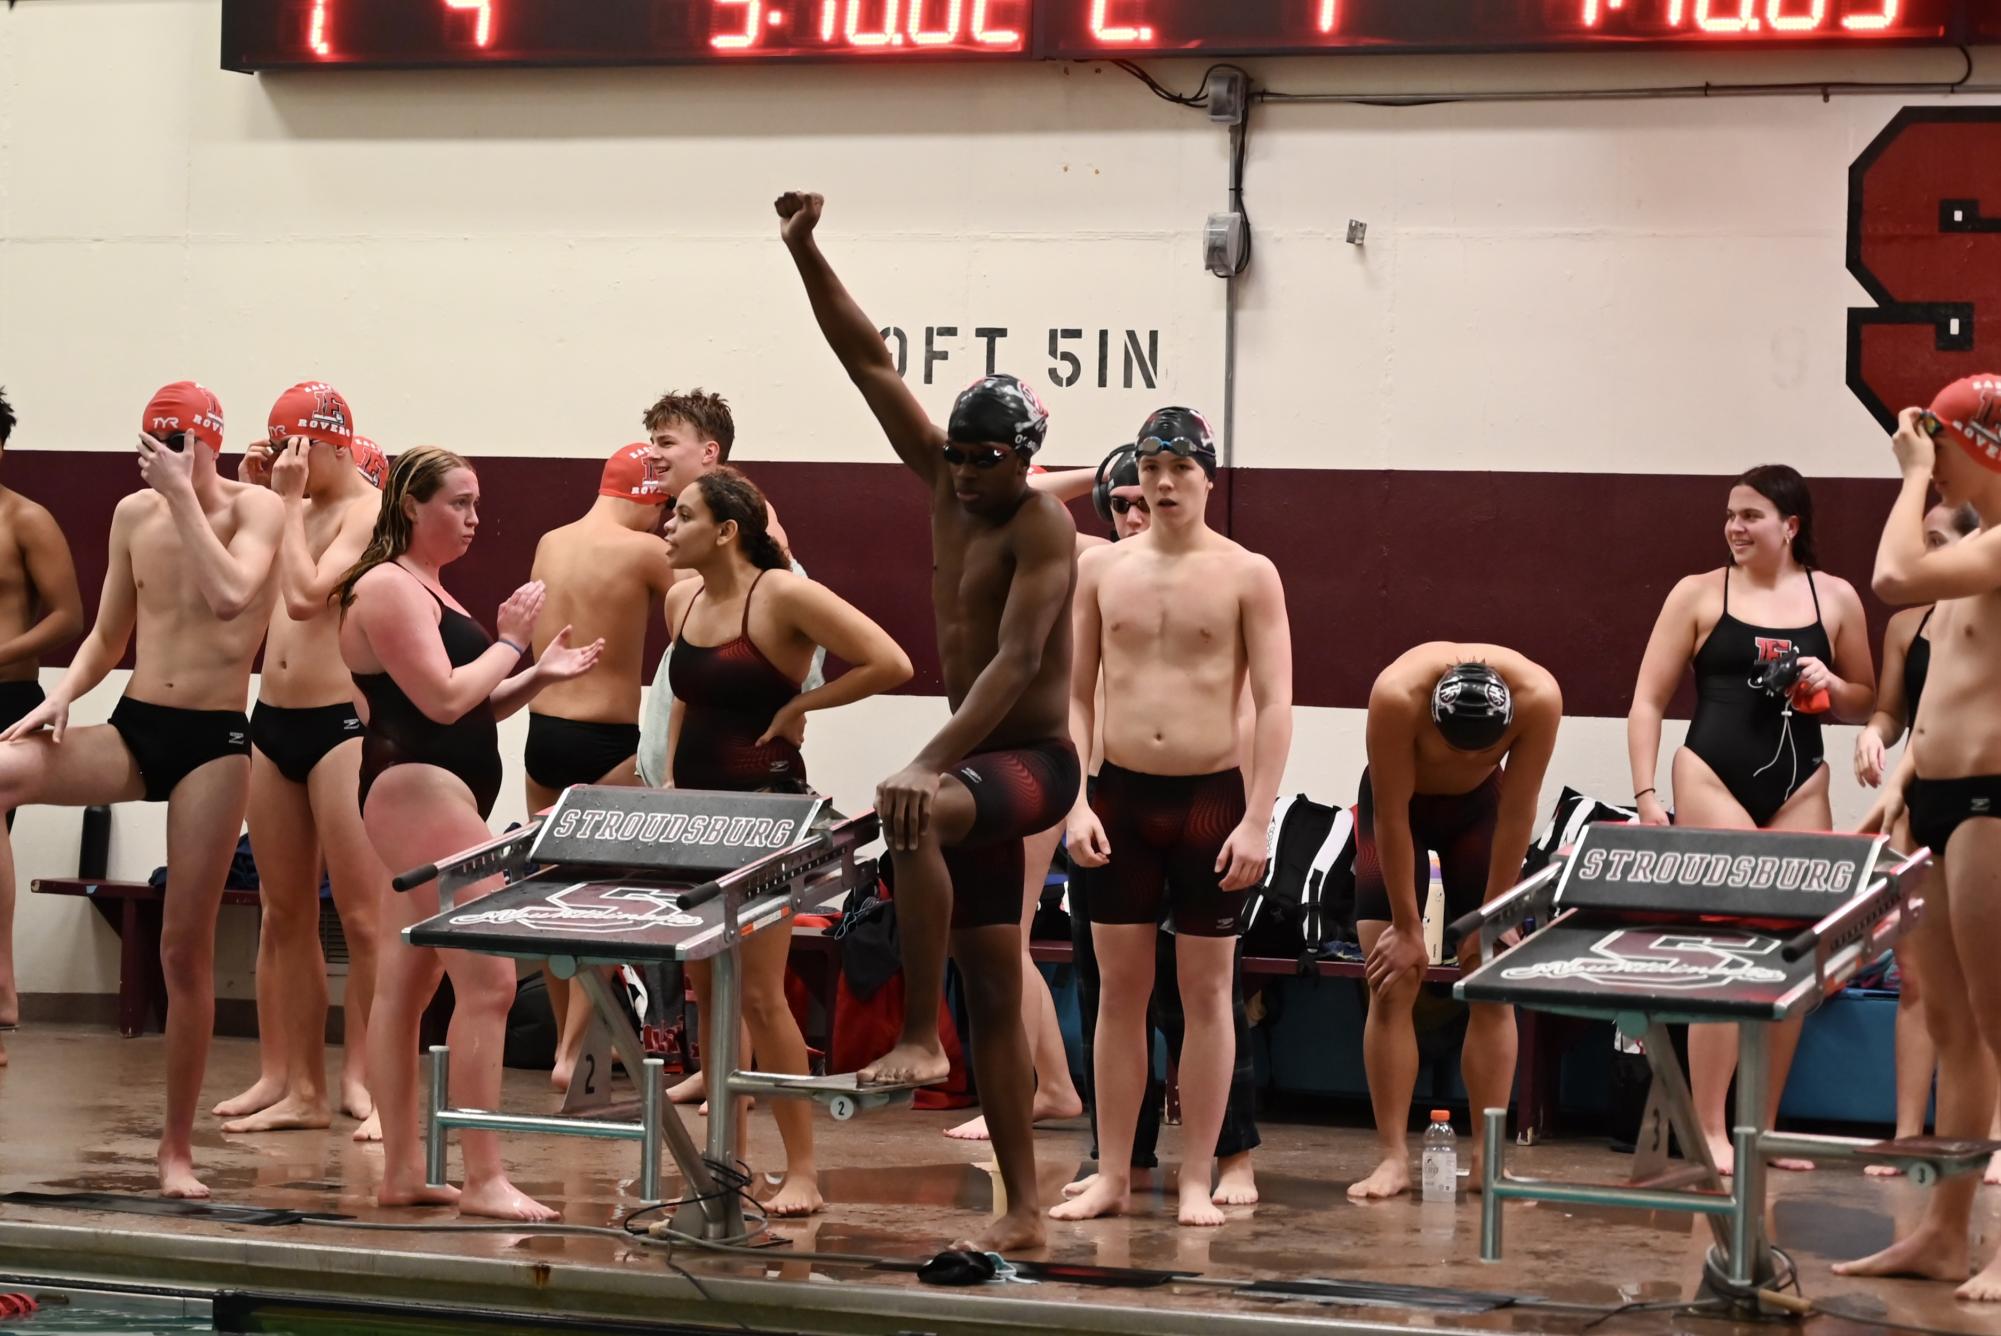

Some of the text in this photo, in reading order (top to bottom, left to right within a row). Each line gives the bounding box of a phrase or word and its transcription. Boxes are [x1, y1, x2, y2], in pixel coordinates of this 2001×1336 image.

[1048, 328, 1158, 388] 5IN
[153, 417, 179, 429] TYR
[554, 808, 795, 848] STROUDSBURG
[1578, 847, 1856, 893] STROUDSBURG
[584, 1053, 596, 1095] 2
[837, 1100, 846, 1117] 2
